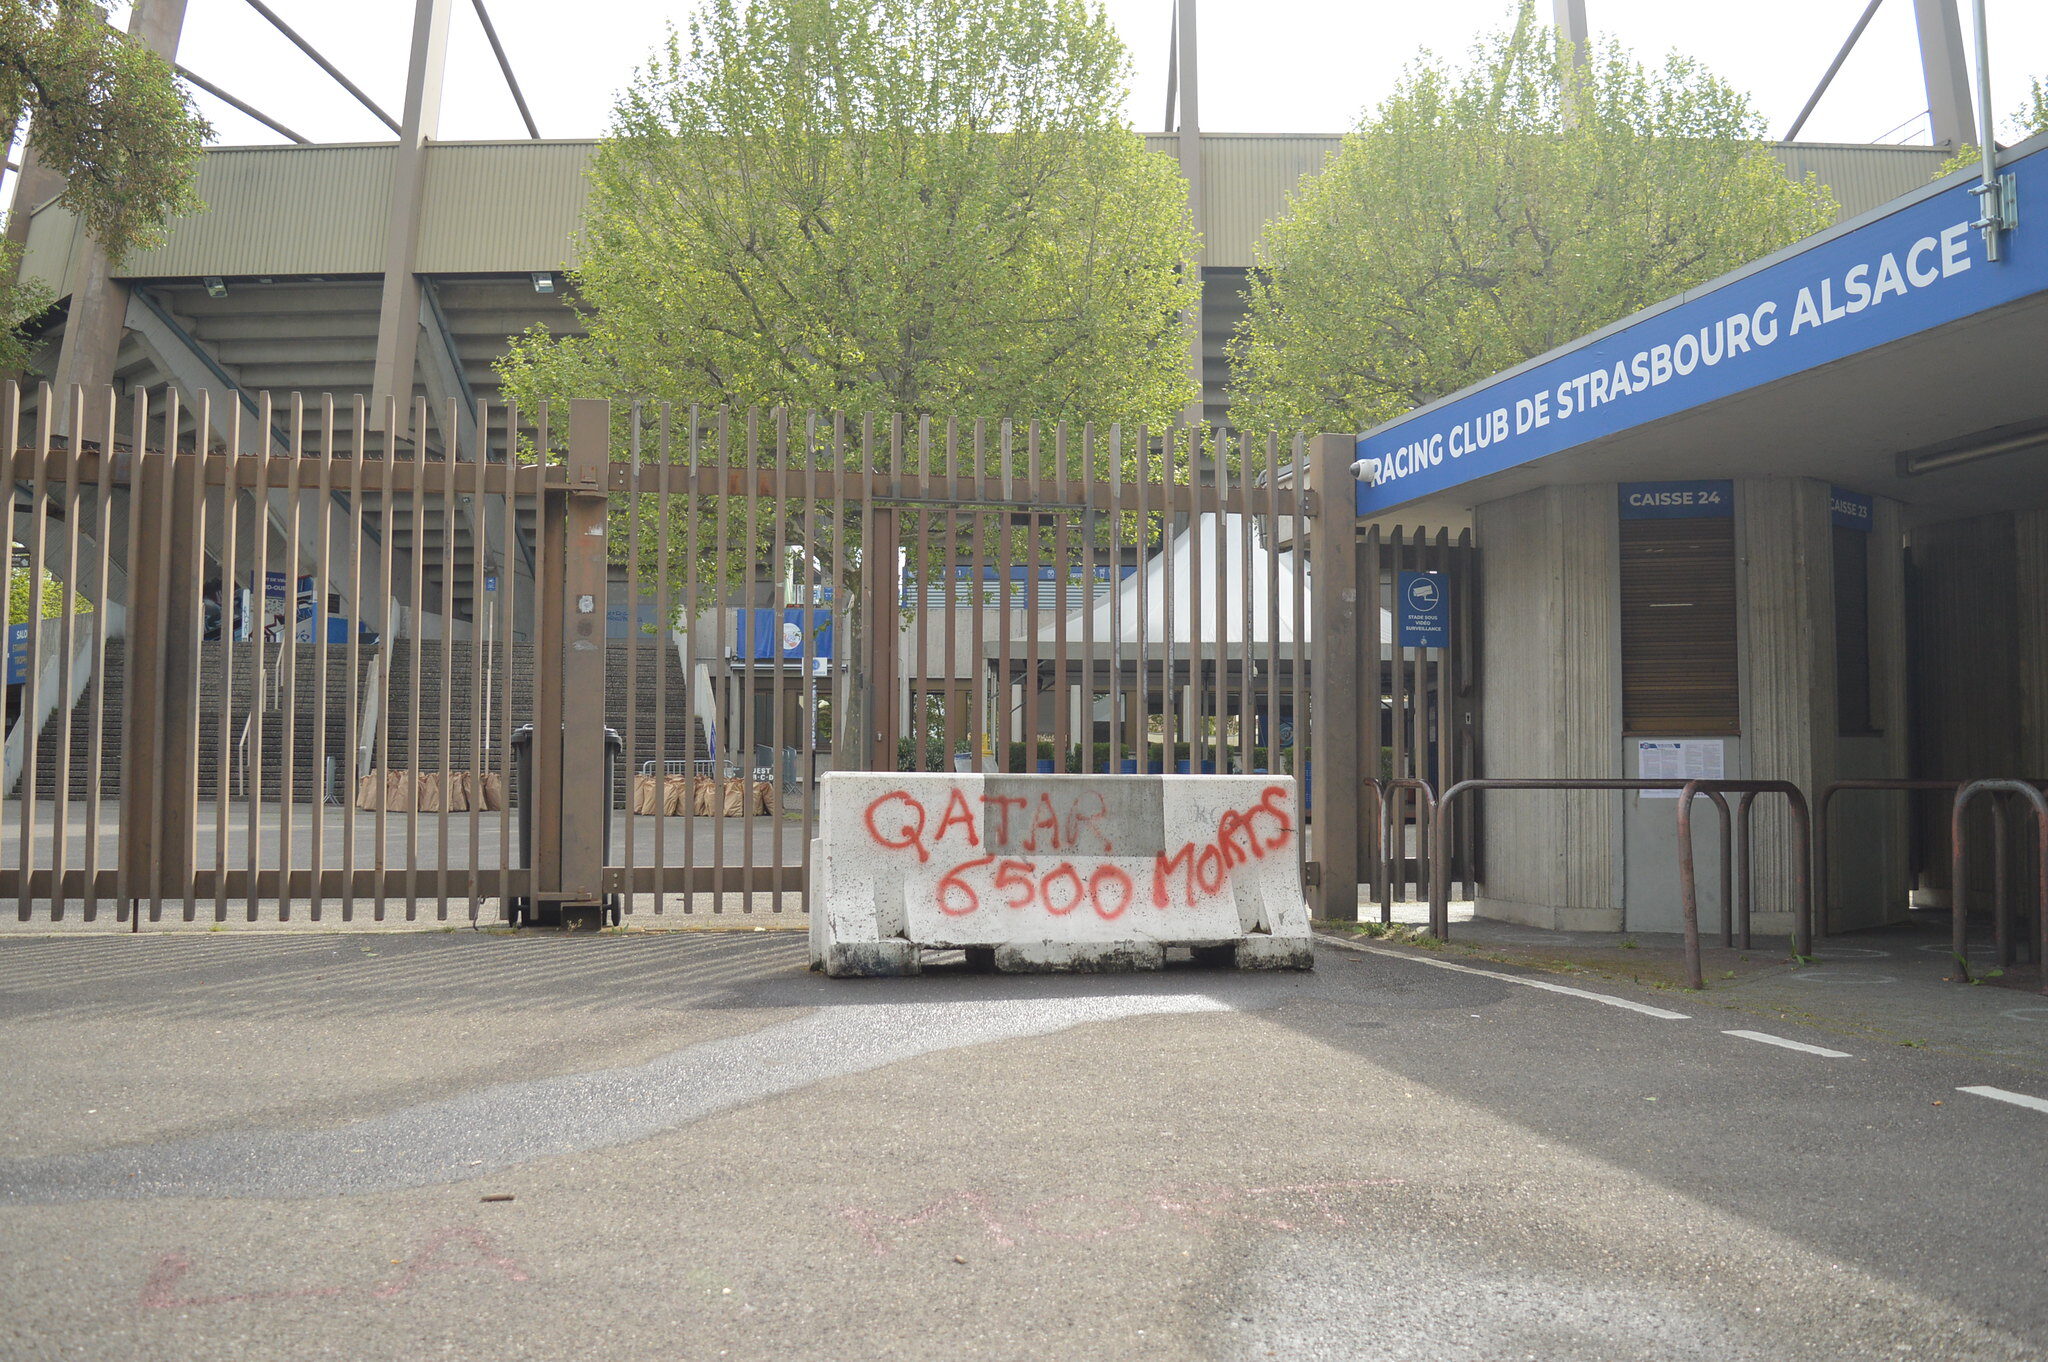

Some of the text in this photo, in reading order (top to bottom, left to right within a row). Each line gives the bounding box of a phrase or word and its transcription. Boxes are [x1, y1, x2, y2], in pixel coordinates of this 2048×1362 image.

[1370, 221, 1971, 487] RACING CLUB DE STRASBOURG ALSACE
[1629, 490, 1720, 507] CAISSE 24
[1858, 504, 1868, 518] 23
[863, 787, 1111, 863] QATAR
[935, 786, 1290, 920] 6500 MORTS
